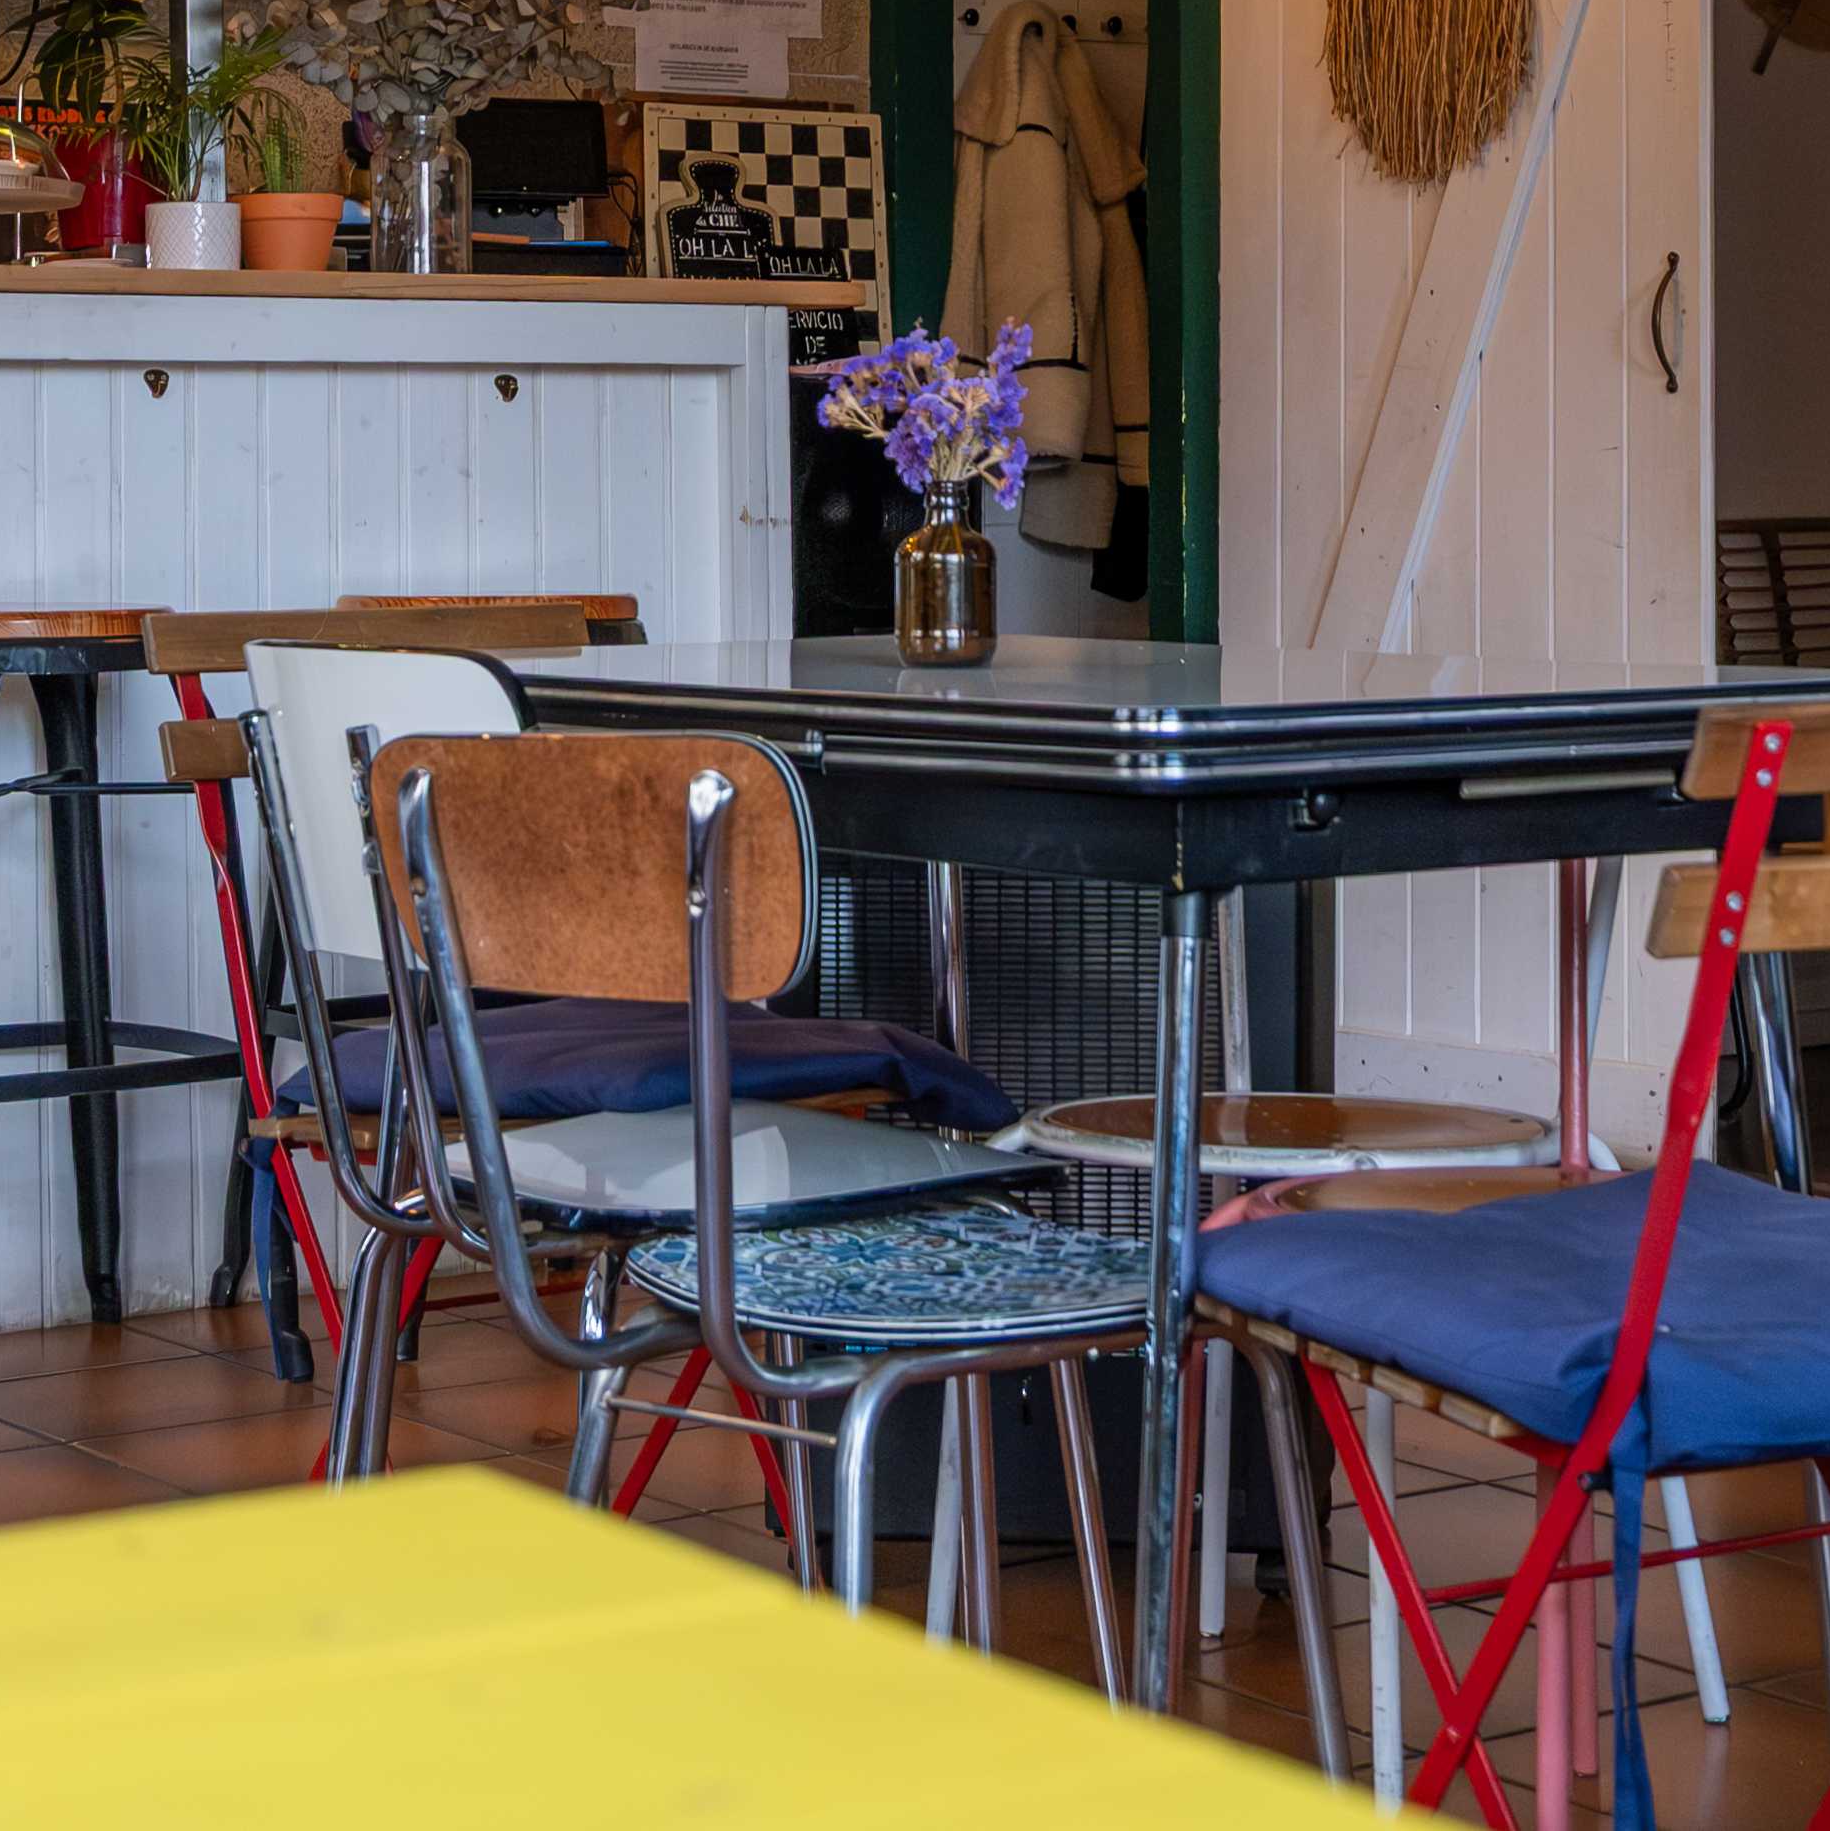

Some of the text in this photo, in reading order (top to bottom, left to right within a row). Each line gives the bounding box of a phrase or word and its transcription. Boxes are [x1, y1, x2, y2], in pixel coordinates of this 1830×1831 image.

[679, 237, 704, 258] OH
[711, 239, 735, 259] LA
[770, 256, 791, 274] OH
[789, 310, 844, 331] ERVICIO
[805, 336, 827, 355] DE
